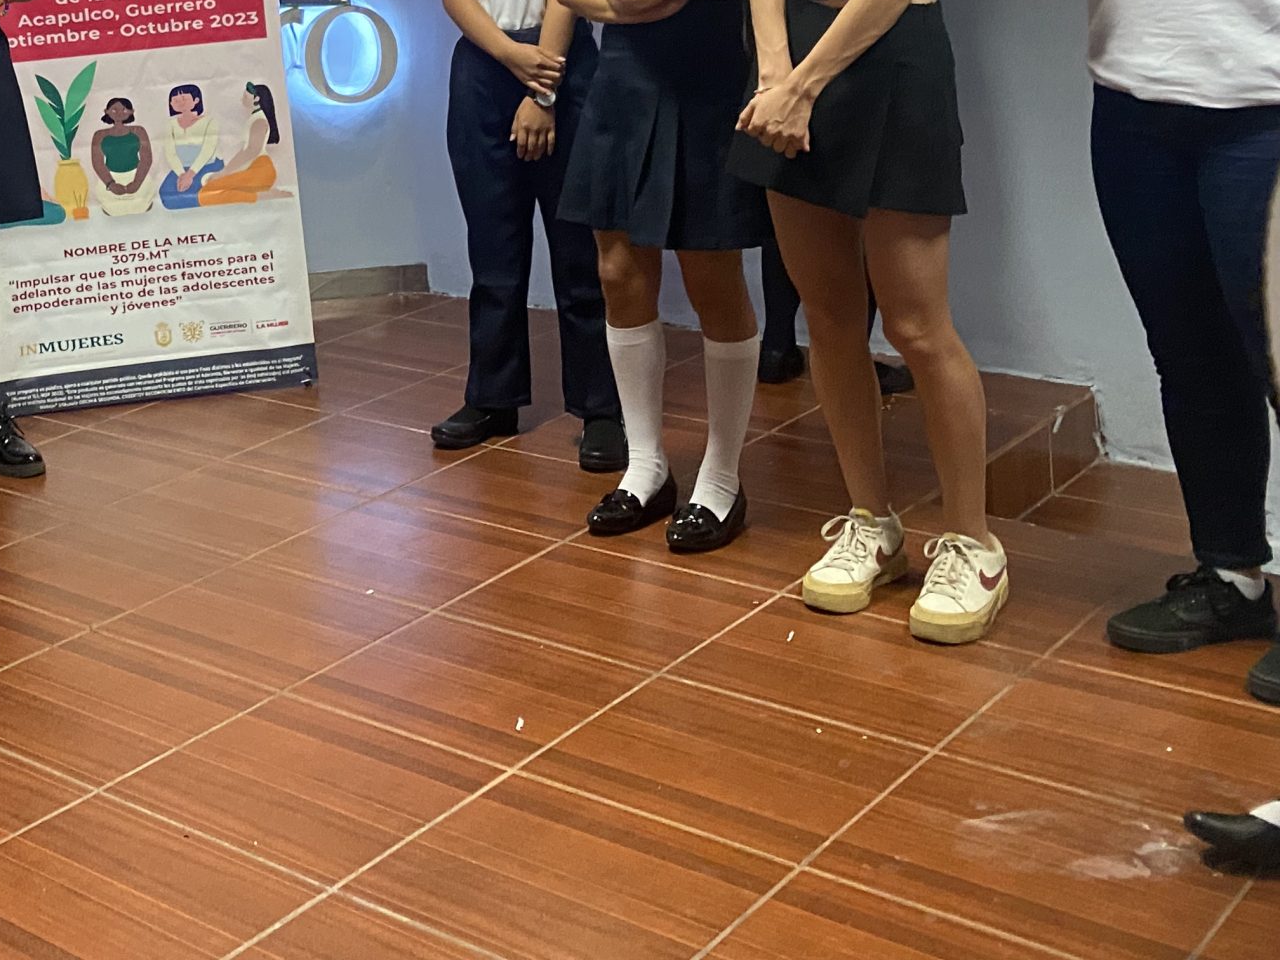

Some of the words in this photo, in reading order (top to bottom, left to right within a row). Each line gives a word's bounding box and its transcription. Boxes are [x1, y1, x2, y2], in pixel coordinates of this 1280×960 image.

[18, 8, 120, 28] Acapulco,
[126, 0, 217, 17] Guerrero
[8, 29, 101, 49] ptiembre
[120, 19, 204, 37] Octubre
[210, 12, 259, 28] 2023
[64, 243, 126, 258] NOMBRE
[131, 240, 151, 251] DE
[155, 237, 173, 247] LA
[177, 233, 217, 245] META
[112, 249, 170, 265] 3079.MT
[80, 270, 107, 282] que
[110, 267, 130, 277] los
[135, 258, 223, 274] mecanismos
[228, 253, 257, 266] para
[261, 250, 274, 260] el
[12, 286, 72, 302] adelanto
[76, 283, 93, 293] de
[97, 281, 117, 291] las
[121, 273, 178, 289] mujeres
[182, 265, 257, 281] favorezcan
[261, 262, 274, 272] el
[13, 291, 133, 314] empoderamiento
[138, 288, 155, 298] de
[160, 286, 179, 296] las
[183, 275, 276, 293] adolescentes
[110, 304, 118, 315] y
[20, 332, 124, 357] INMUJERES
